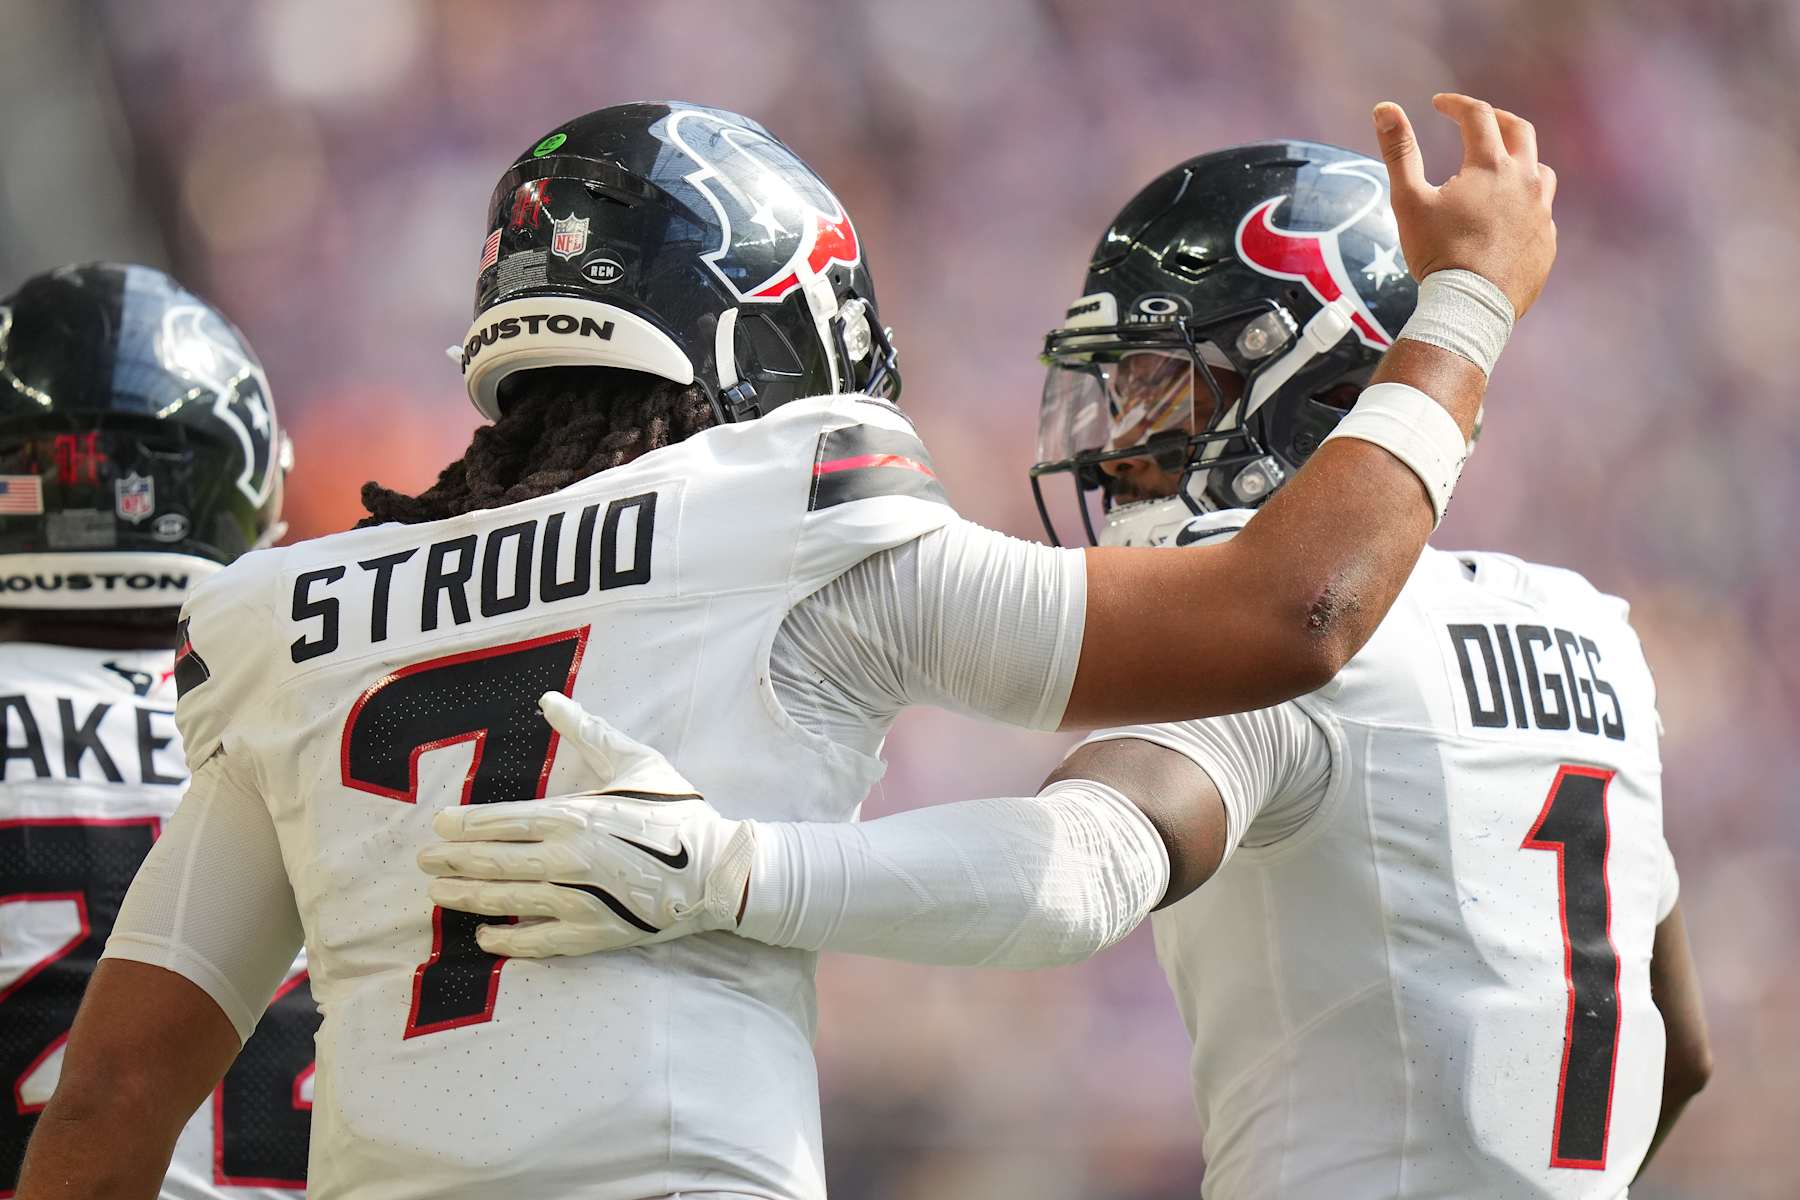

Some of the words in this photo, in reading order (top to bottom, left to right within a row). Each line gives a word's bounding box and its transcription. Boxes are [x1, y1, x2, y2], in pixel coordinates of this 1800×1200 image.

[555, 233, 582, 254] NFL
[590, 265, 615, 277] RCM
[461, 314, 615, 374] HOUSTON
[0, 573, 189, 593] OUSTON
[291, 491, 658, 664] STROUD
[1447, 623, 1626, 742] DIGGS
[341, 624, 591, 1040] 7
[1520, 764, 1617, 1170] 1
